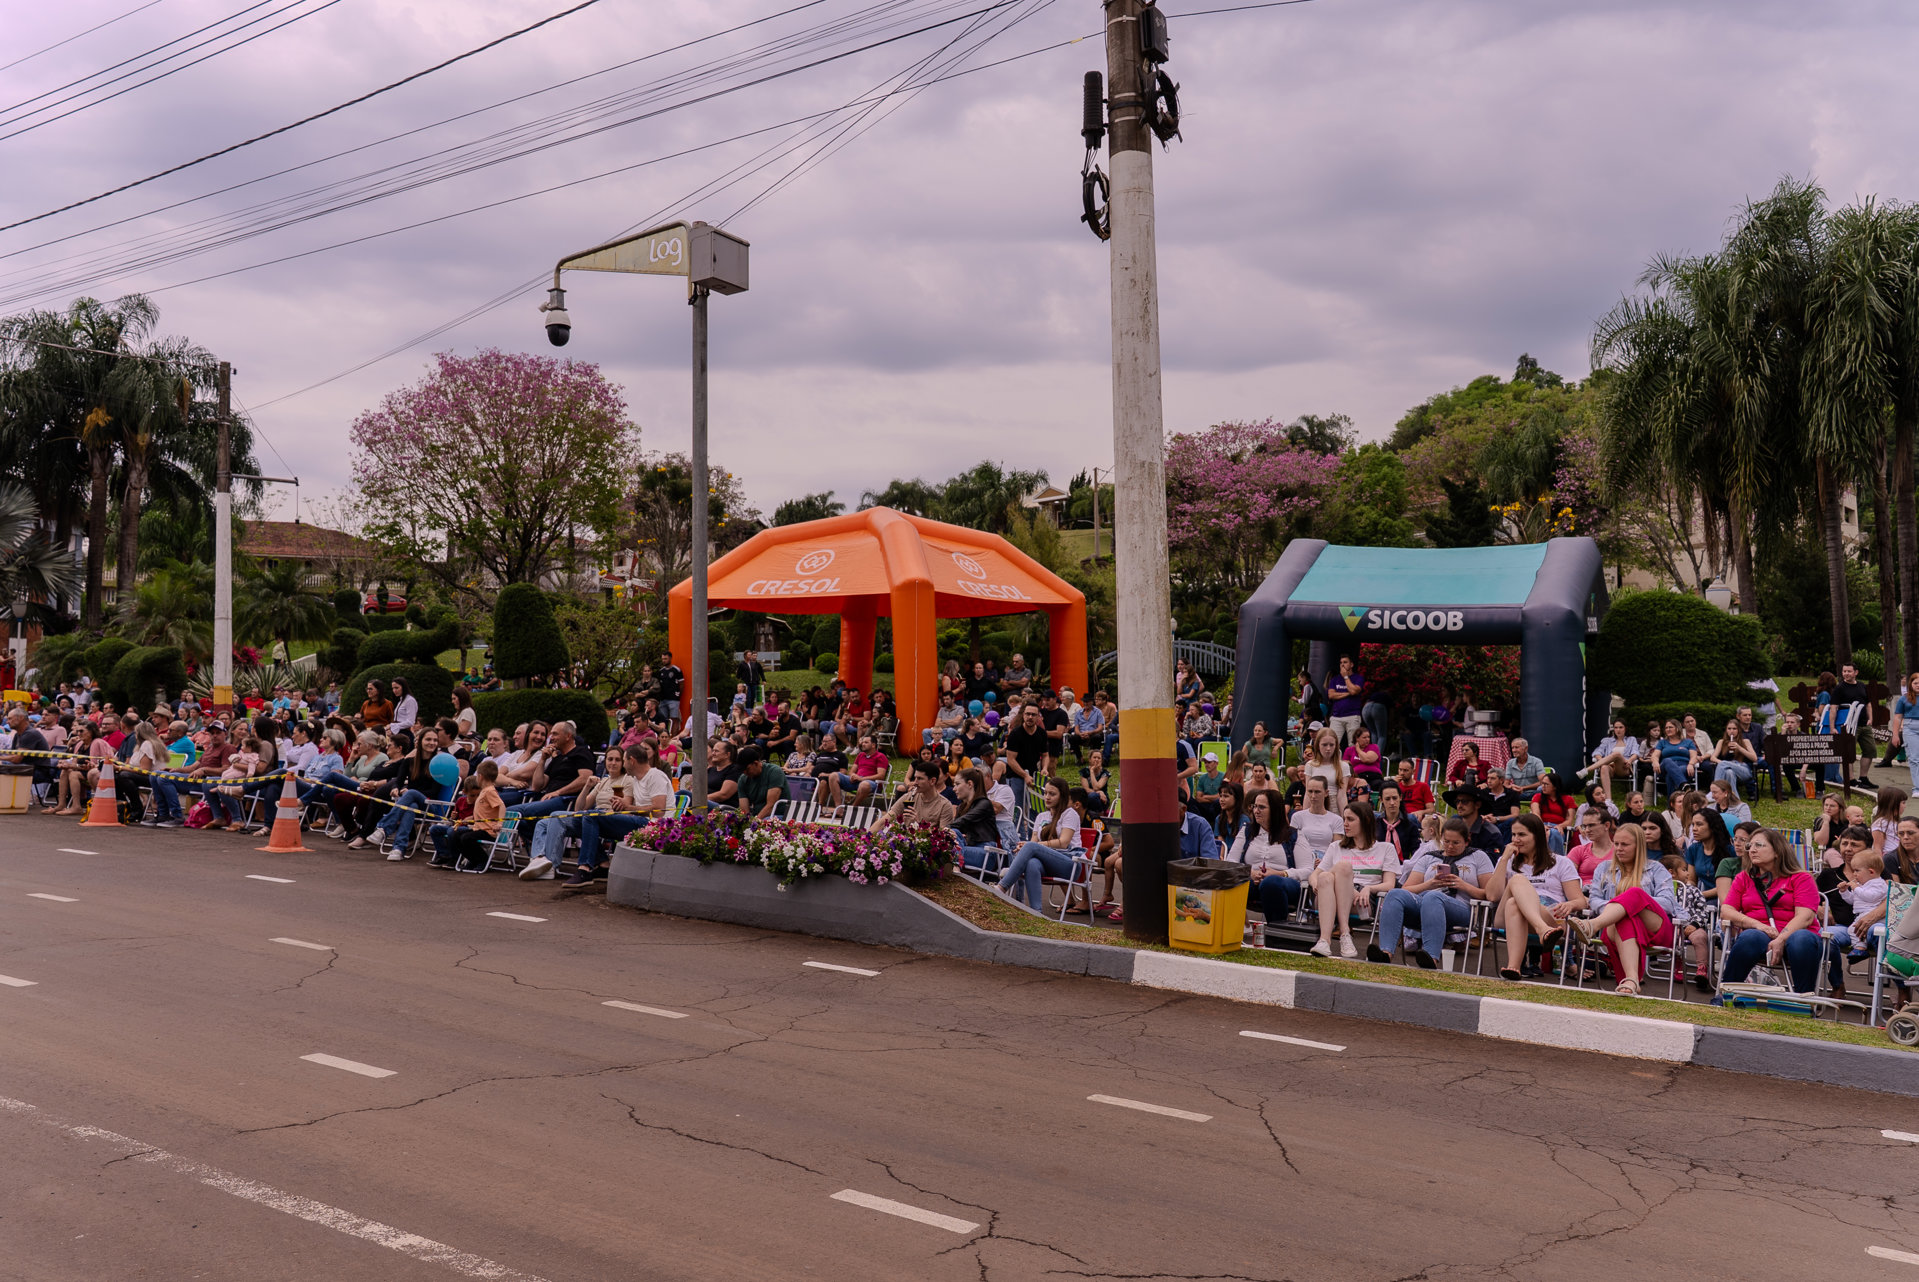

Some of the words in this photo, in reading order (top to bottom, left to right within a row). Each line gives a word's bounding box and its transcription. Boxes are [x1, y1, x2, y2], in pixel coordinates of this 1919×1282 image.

[747, 577, 841, 595] CRESOL
[957, 580, 1032, 600] CRESOL
[1367, 609, 1464, 631] SICOOB
[1781, 756, 1789, 764] ATÉ
